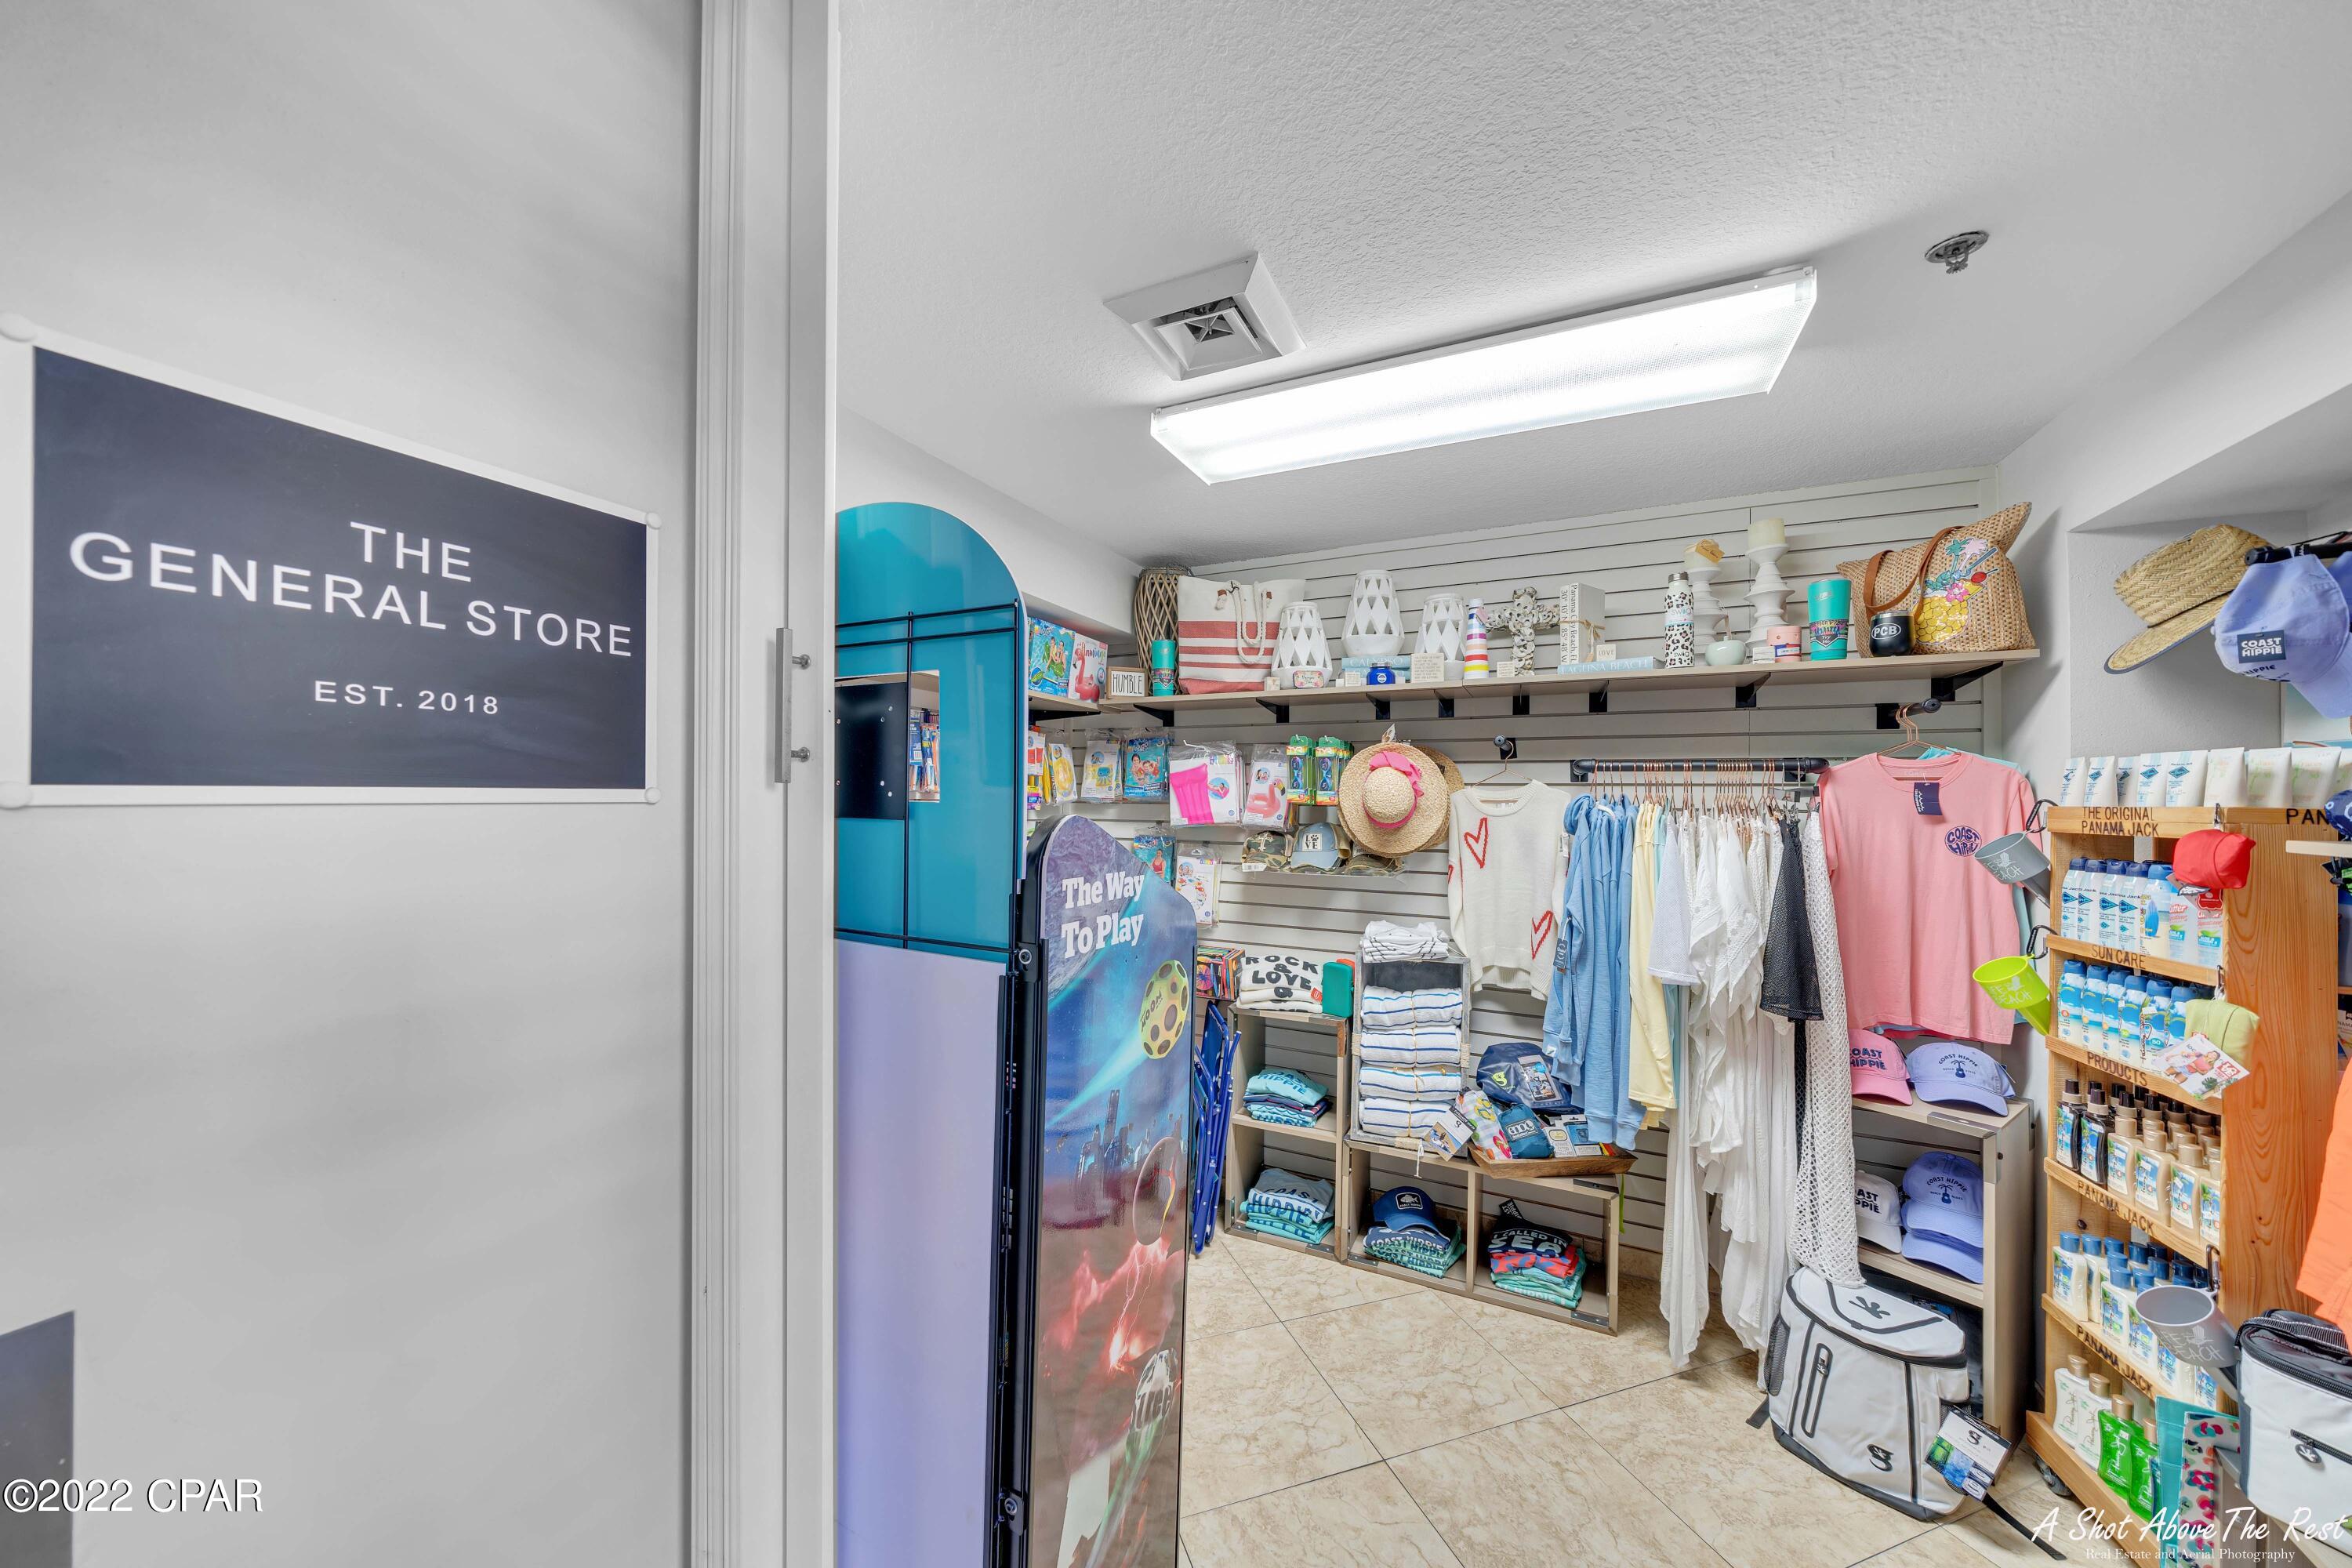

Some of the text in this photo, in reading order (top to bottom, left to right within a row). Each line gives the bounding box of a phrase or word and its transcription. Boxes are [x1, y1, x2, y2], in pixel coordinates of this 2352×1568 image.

[350, 521, 472, 583] THE
[69, 532, 632, 657] GENERAL STORE
[1873, 625, 1897, 637] PCB
[2241, 637, 2281, 648] COAST
[2241, 646, 2283, 657] HIPPIE
[1611, 659, 1647, 670] BEACH
[1113, 673, 1142, 694] HUMBLE
[314, 681, 499, 715] EST. 2018
[2082, 806, 2155, 822] THE ORIGINAL
[1947, 827, 1980, 844] COAST
[2082, 820, 2159, 837] PANAMA JACK
[1062, 871, 1145, 909] The Way
[2169, 903, 2188, 914] utter
[1061, 912, 1145, 959] To Play
[1245, 955, 1319, 975] ROCK
[2091, 944, 2147, 970] SUN CARE
[1273, 963, 1292, 974] &
[1252, 970, 1312, 991] LOVE
[1938, 1054, 1978, 1067] COAST HIPPIE
[2087, 1051, 2148, 1087] PRODUCTS
[1926, 1176, 1968, 1192] COAST HIPPIE
[1855, 1189, 1878, 1202] AST
[1855, 1200, 1882, 1214] PPIE
[2078, 1179, 2154, 1235] PANAMA JACK
[1502, 1230, 1548, 1240] CALLED
[1554, 1238, 1568, 1248] IN
[2078, 1325, 2120, 1370] PANAMA
[2122, 1366, 2154, 1393] JACK
